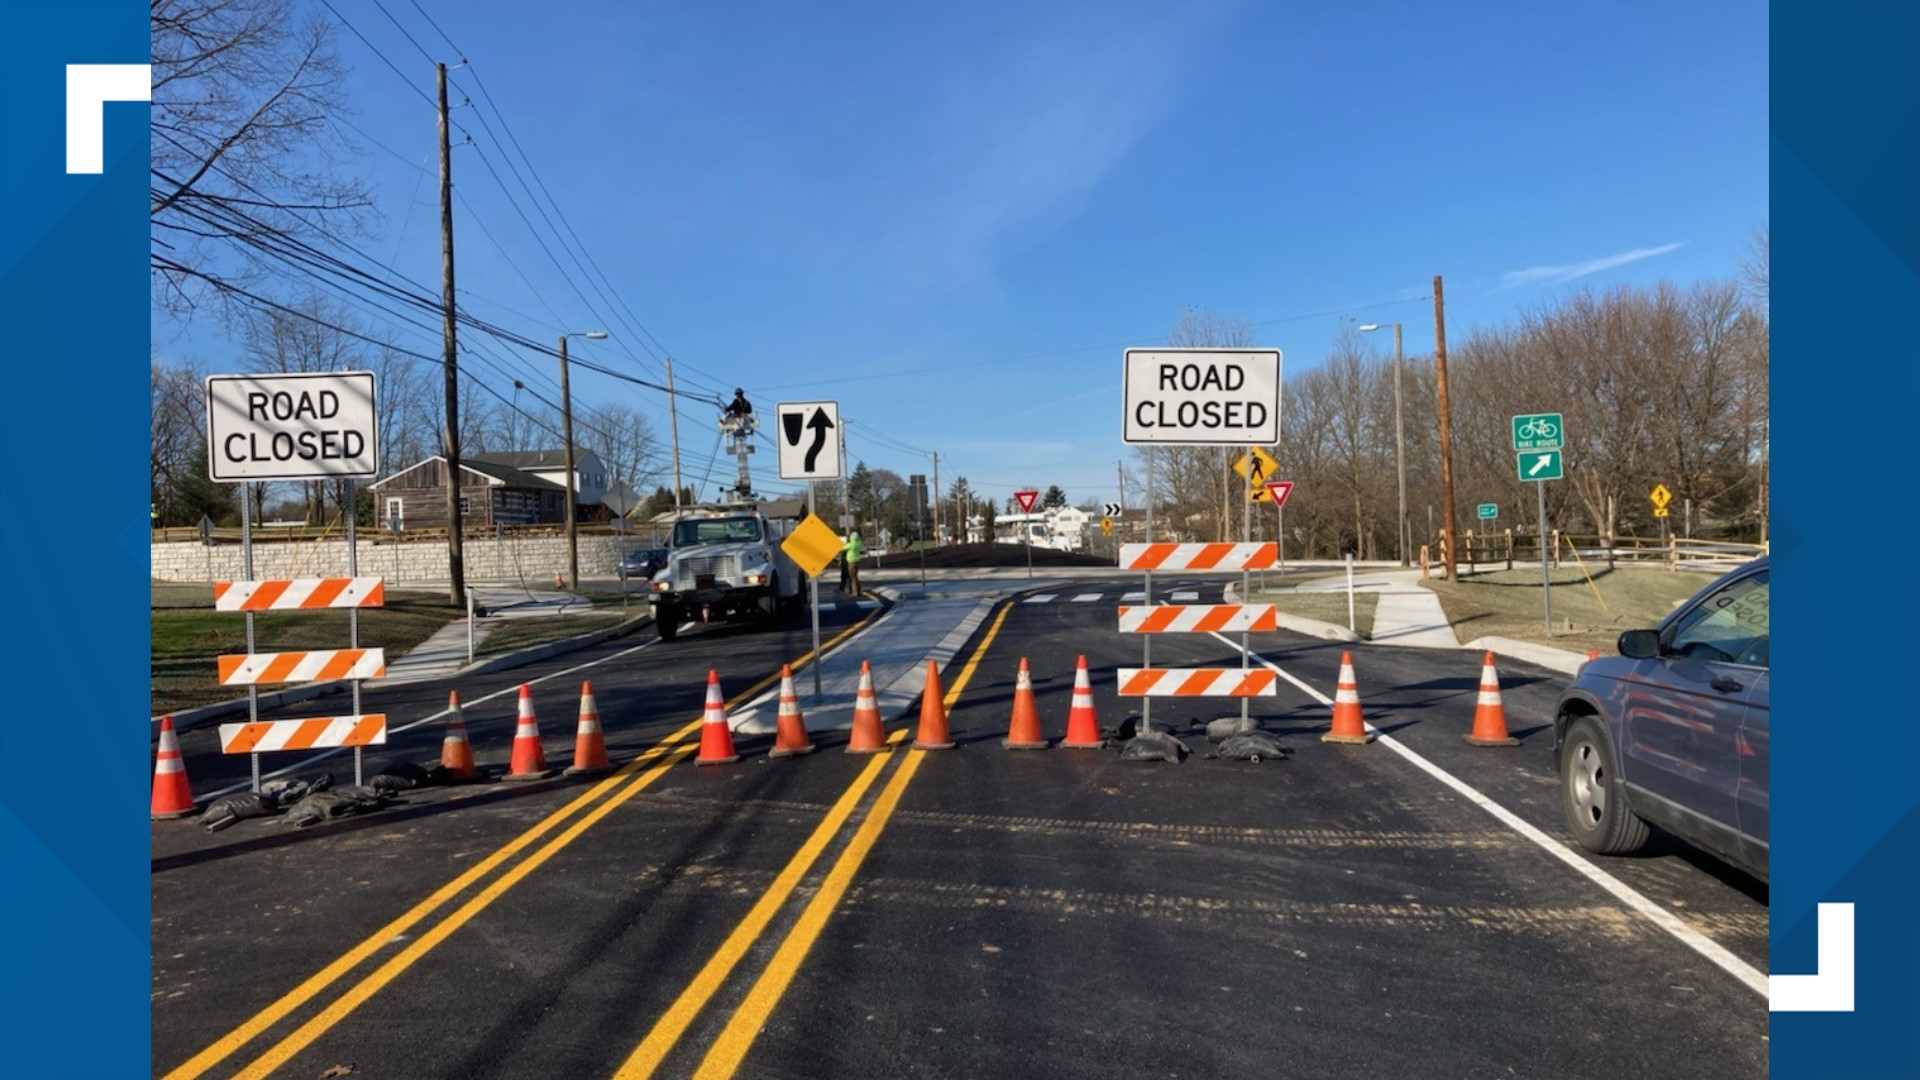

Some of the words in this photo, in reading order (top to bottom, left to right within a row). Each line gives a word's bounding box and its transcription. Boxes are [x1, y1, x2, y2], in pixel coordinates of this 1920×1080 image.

[1160, 364, 1244, 391] ROAD
[248, 390, 339, 421] ROAD
[1136, 400, 1266, 428] CLOSED
[224, 430, 364, 463] CLOSED
